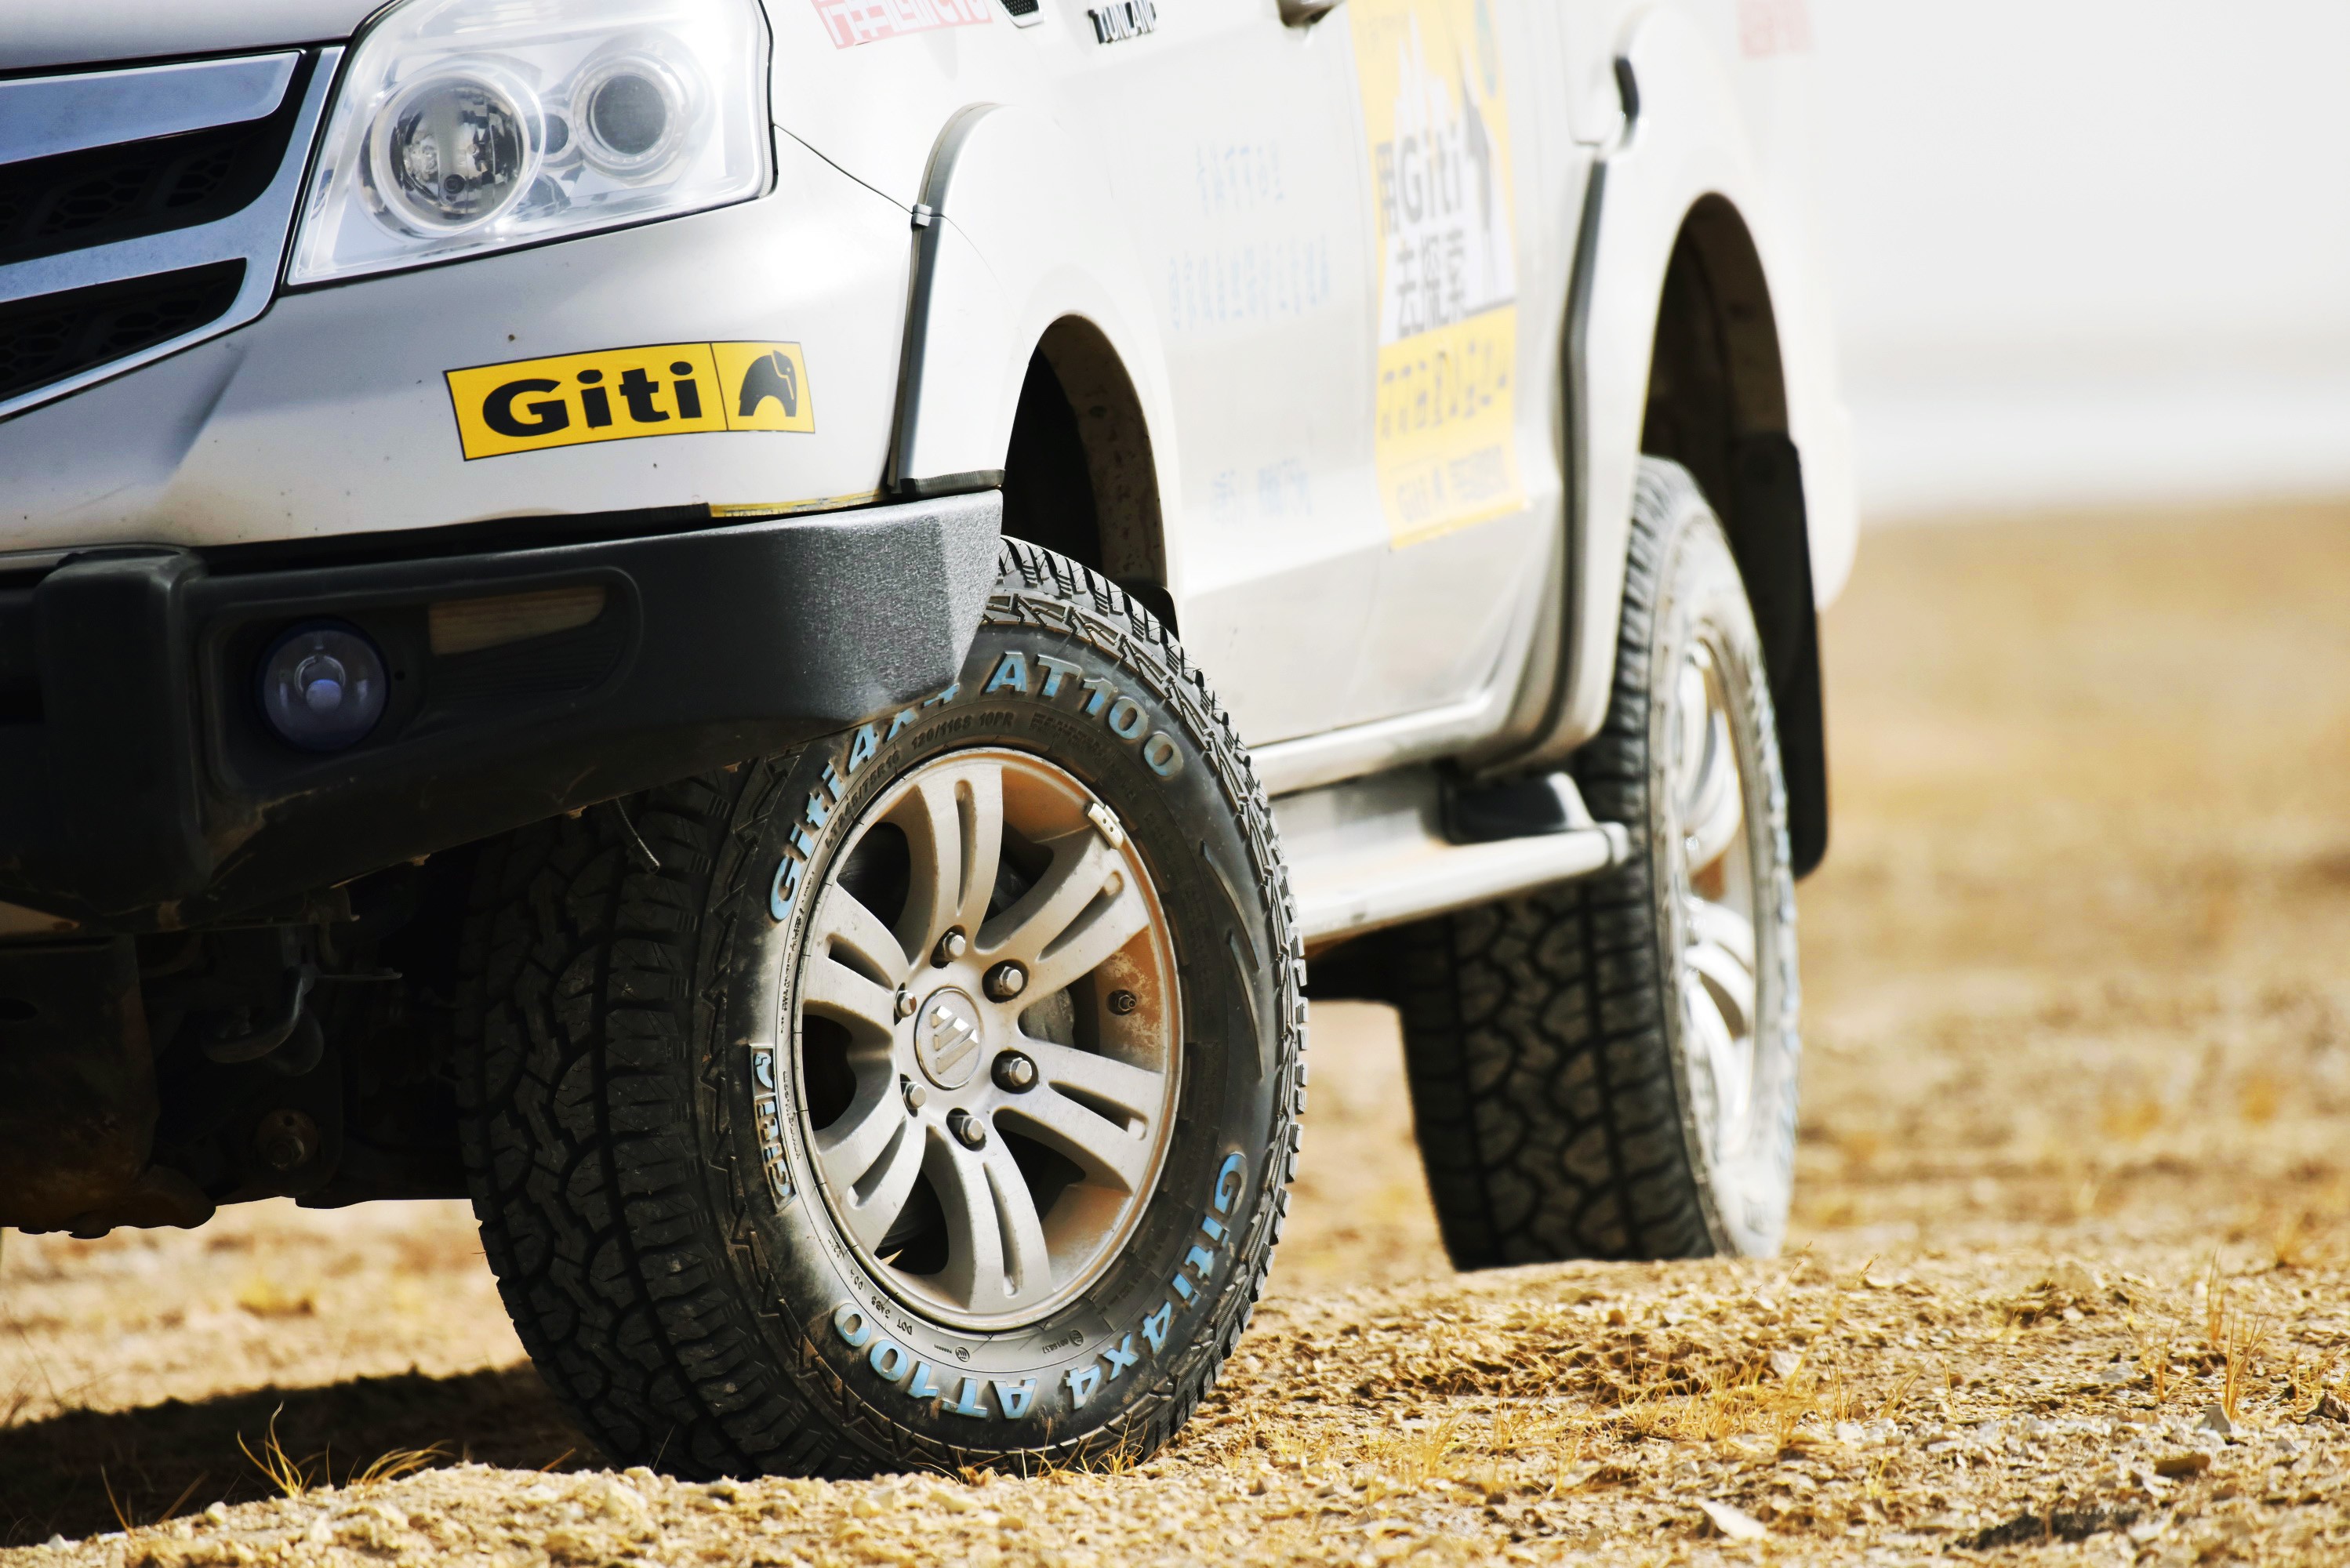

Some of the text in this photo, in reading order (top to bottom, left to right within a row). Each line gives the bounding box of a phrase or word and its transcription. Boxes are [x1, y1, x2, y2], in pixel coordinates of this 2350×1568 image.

[482, 361, 703, 437] Giti
[982, 650, 1183, 778] AT100
[758, 1100, 792, 1198] Giti
[834, 1302, 1037, 1420] AT100
[896, 1318, 913, 1335] DOT
